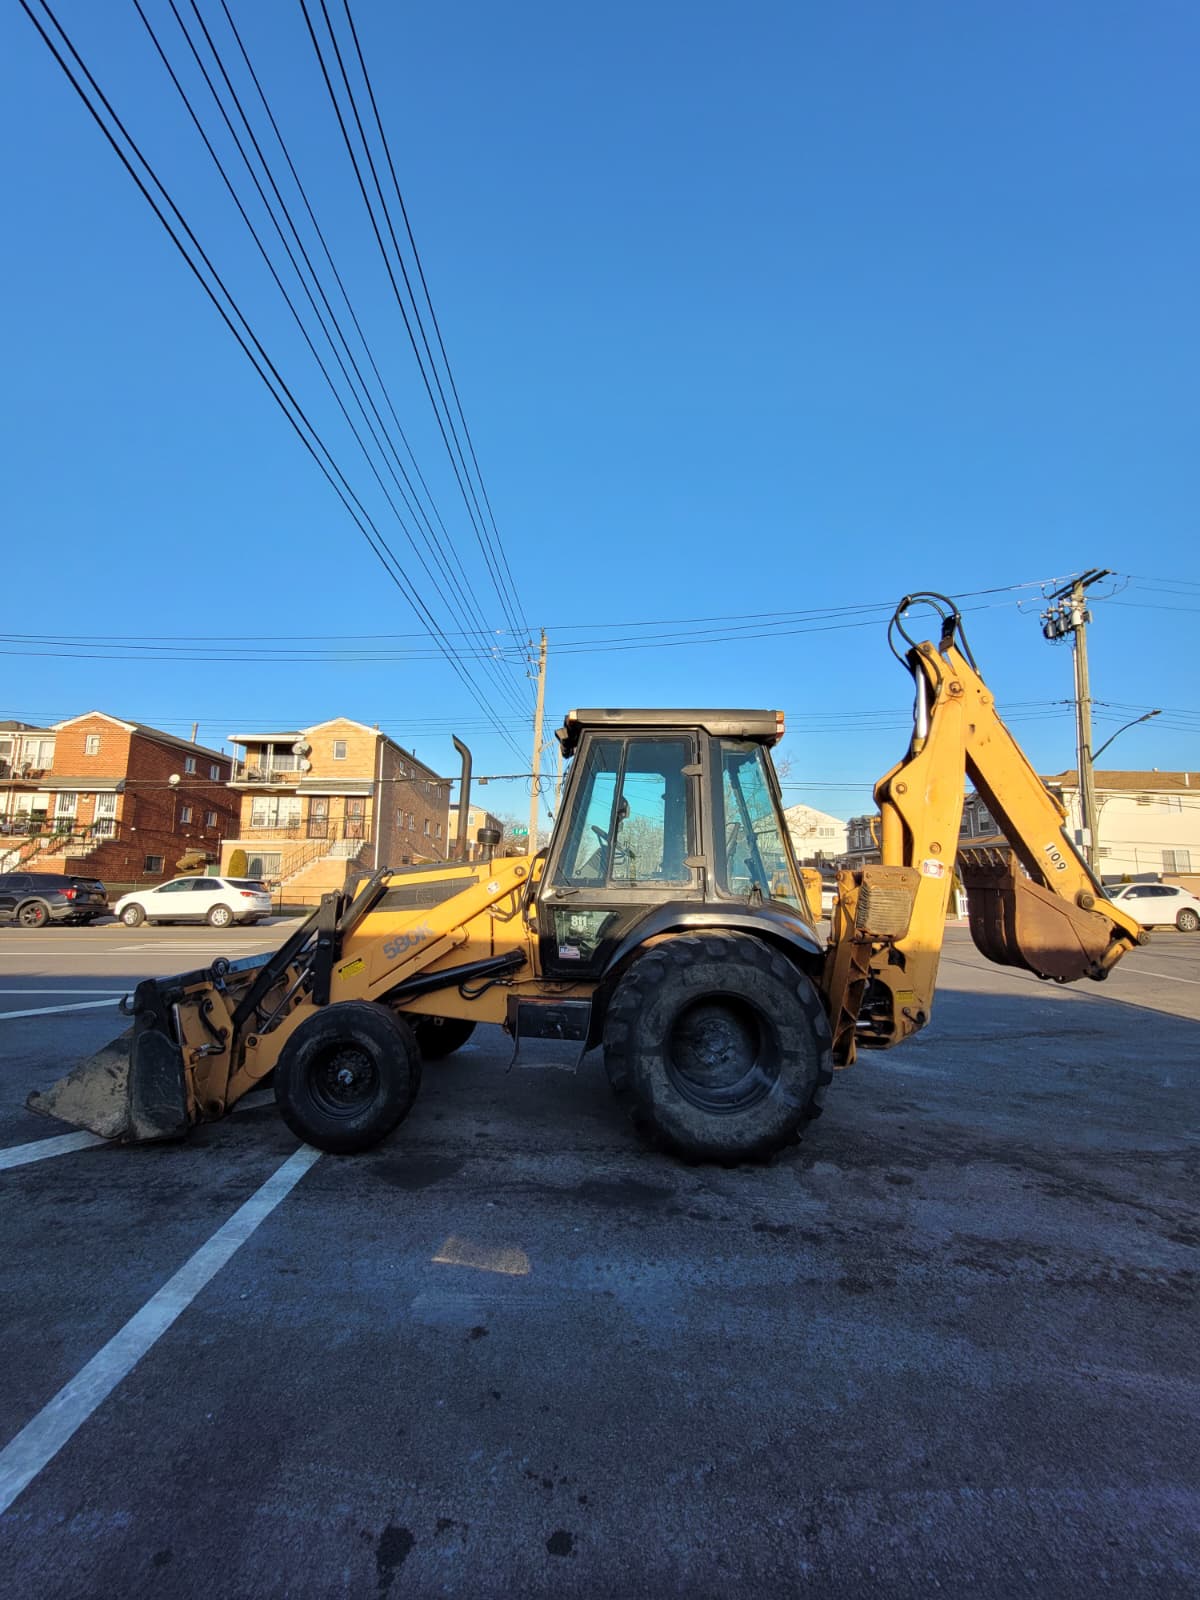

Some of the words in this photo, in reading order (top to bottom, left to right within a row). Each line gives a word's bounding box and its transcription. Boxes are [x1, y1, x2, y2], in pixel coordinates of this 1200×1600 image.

[1045, 845, 1066, 870] 109
[571, 915, 587, 927] 811
[383, 920, 433, 960] 580K
